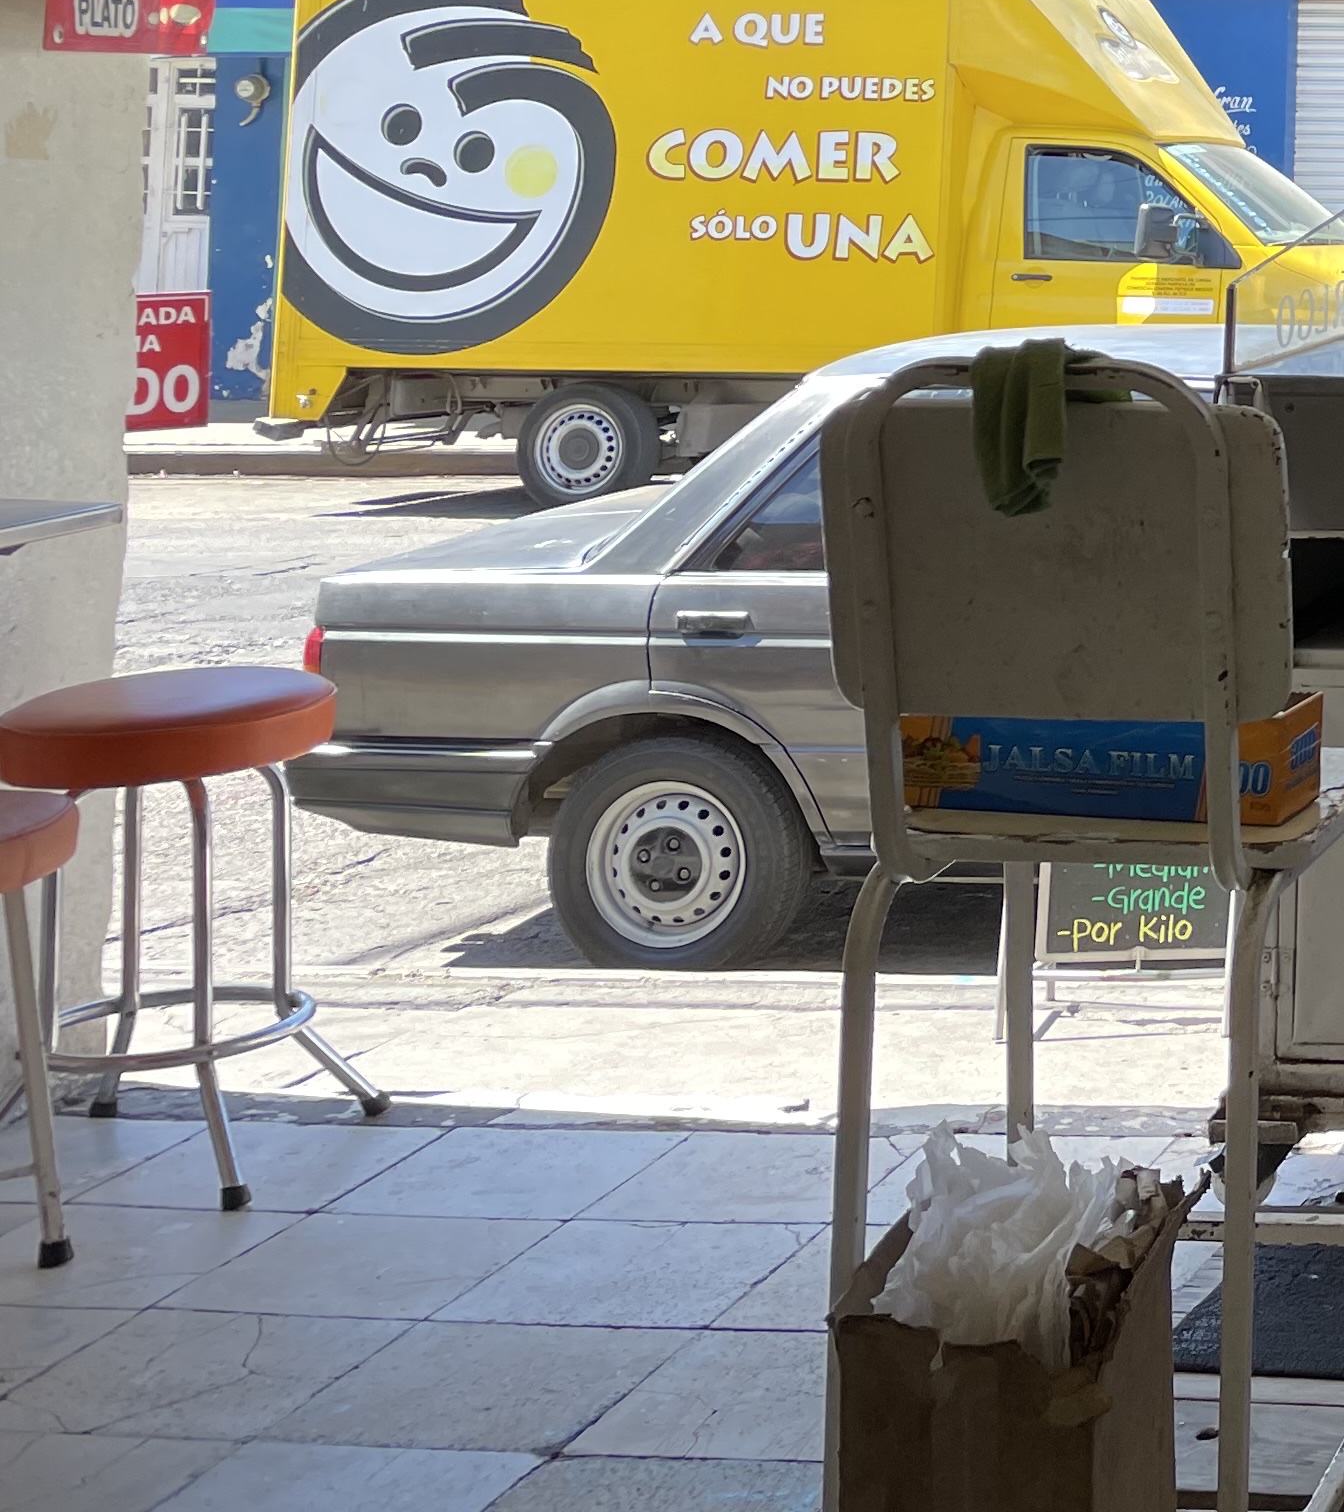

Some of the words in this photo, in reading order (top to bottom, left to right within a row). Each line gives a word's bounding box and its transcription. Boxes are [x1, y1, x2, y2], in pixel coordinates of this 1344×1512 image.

[689, 12, 724, 45] A
[733, 12, 826, 49] QUE
[765, 75, 814, 100] NO
[820, 75, 936, 102] PUEDES
[646, 127, 901, 185] COMER
[690, 207, 778, 240] SÓLO
[784, 212, 935, 264] UNA
[981, 743, 1101, 775] JALSA
[1107, 749, 1196, 781] FILM
[1139, 914, 1193, 944] Kilo
